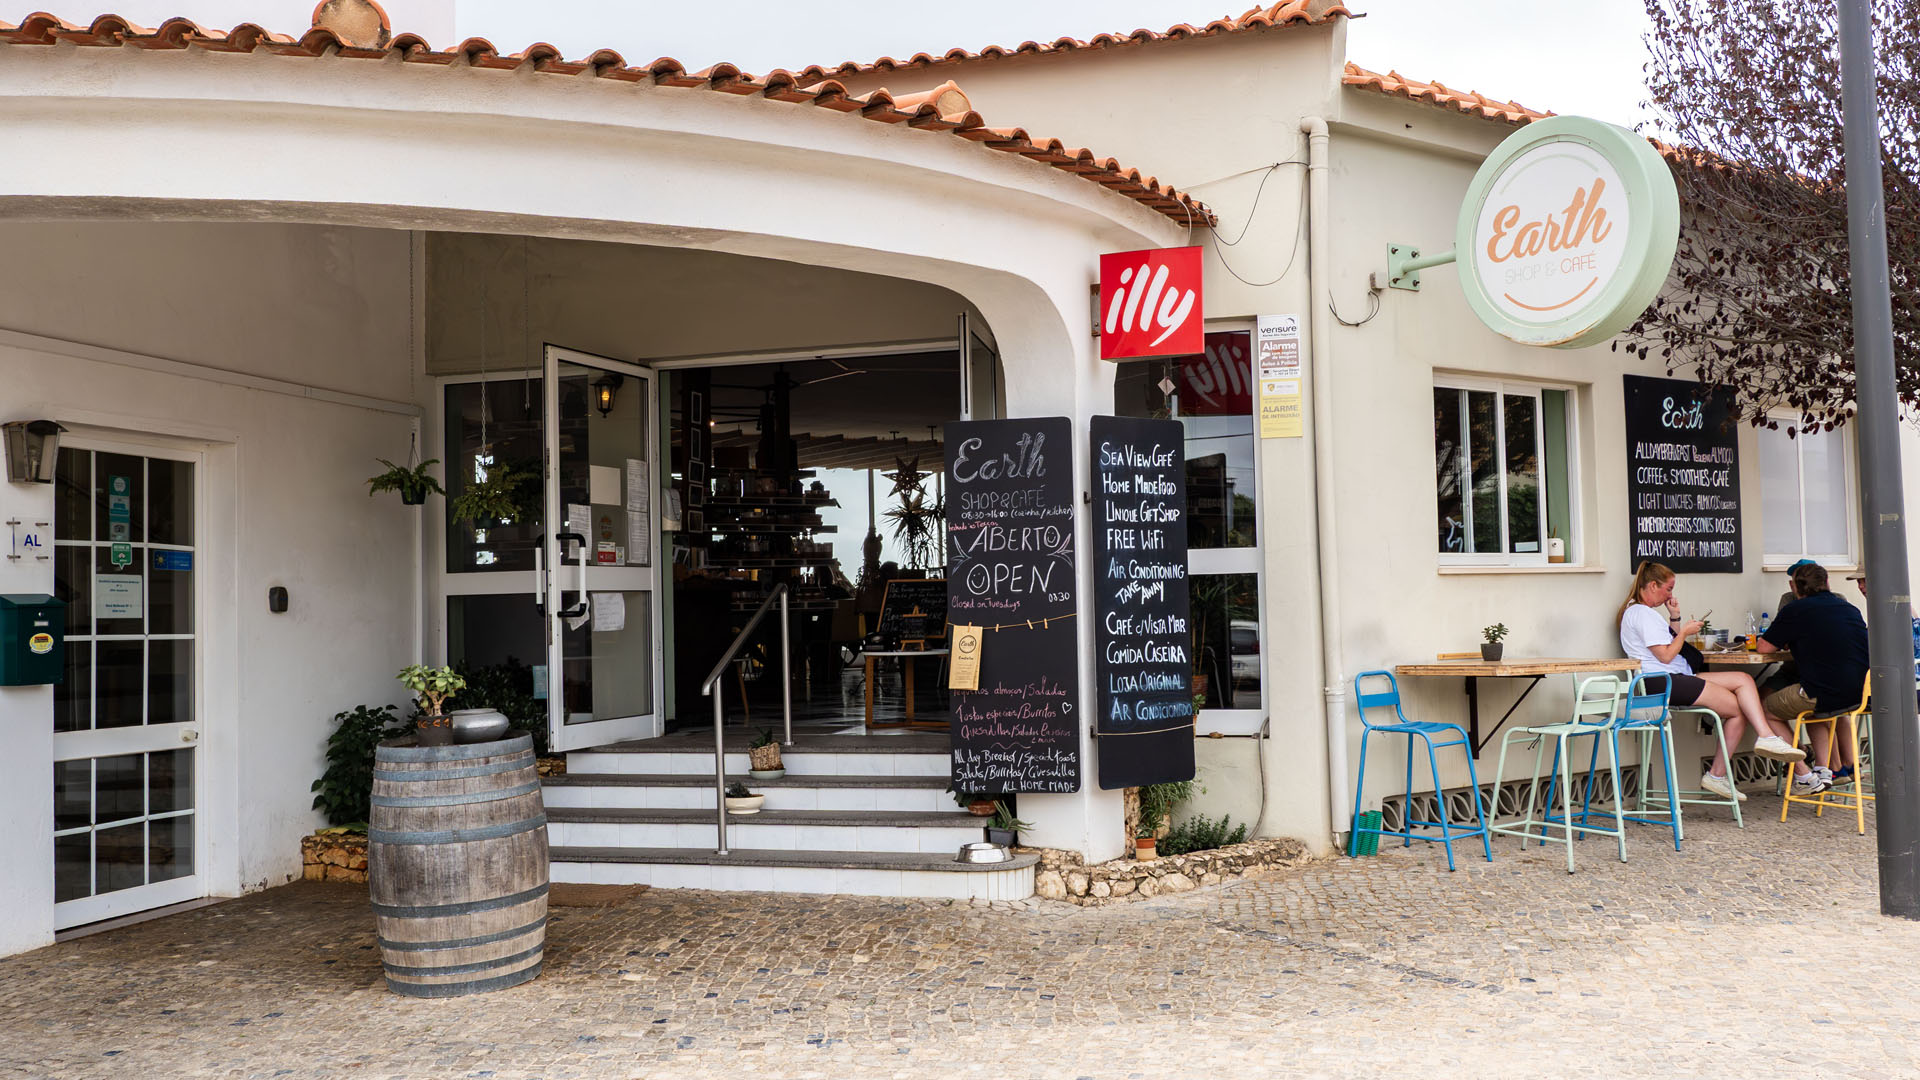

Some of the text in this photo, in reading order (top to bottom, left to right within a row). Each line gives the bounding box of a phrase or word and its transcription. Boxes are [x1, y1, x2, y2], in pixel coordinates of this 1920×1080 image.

[1487, 177, 1613, 263] Earth
[1504, 250, 1597, 285] SHOP & CAFÉ
[1105, 263, 1195, 347] illy
[1260, 325, 1297, 334] verisure
[1262, 341, 1297, 351] Alarme
[953, 432, 1046, 483] Earth
[1100, 442, 1124, 466] SEA
[1152, 444, 1175, 467] CAFÉ
[1103, 473, 1129, 494] HOME
[1637, 466, 1663, 485] COFFEE
[1638, 493, 1662, 510] LIGHT
[1158, 502, 1180, 523] SHOP
[24, 534, 42, 547] AL
[968, 525, 1060, 553] ABERTO
[1107, 529, 1164, 550] FREE WiFi
[1666, 540, 1695, 557] BRUNCH
[967, 561, 1055, 595] OPEN
[952, 595, 974, 609] Closed
[1115, 580, 1164, 605] TAKE AWAY
[1106, 611, 1134, 635] CAFÉ
[1168, 615, 1186, 634] MAR
[1110, 673, 1138, 693] LOJA
[1020, 781, 1046, 792] HOME
[1049, 781, 1075, 792] MADE
